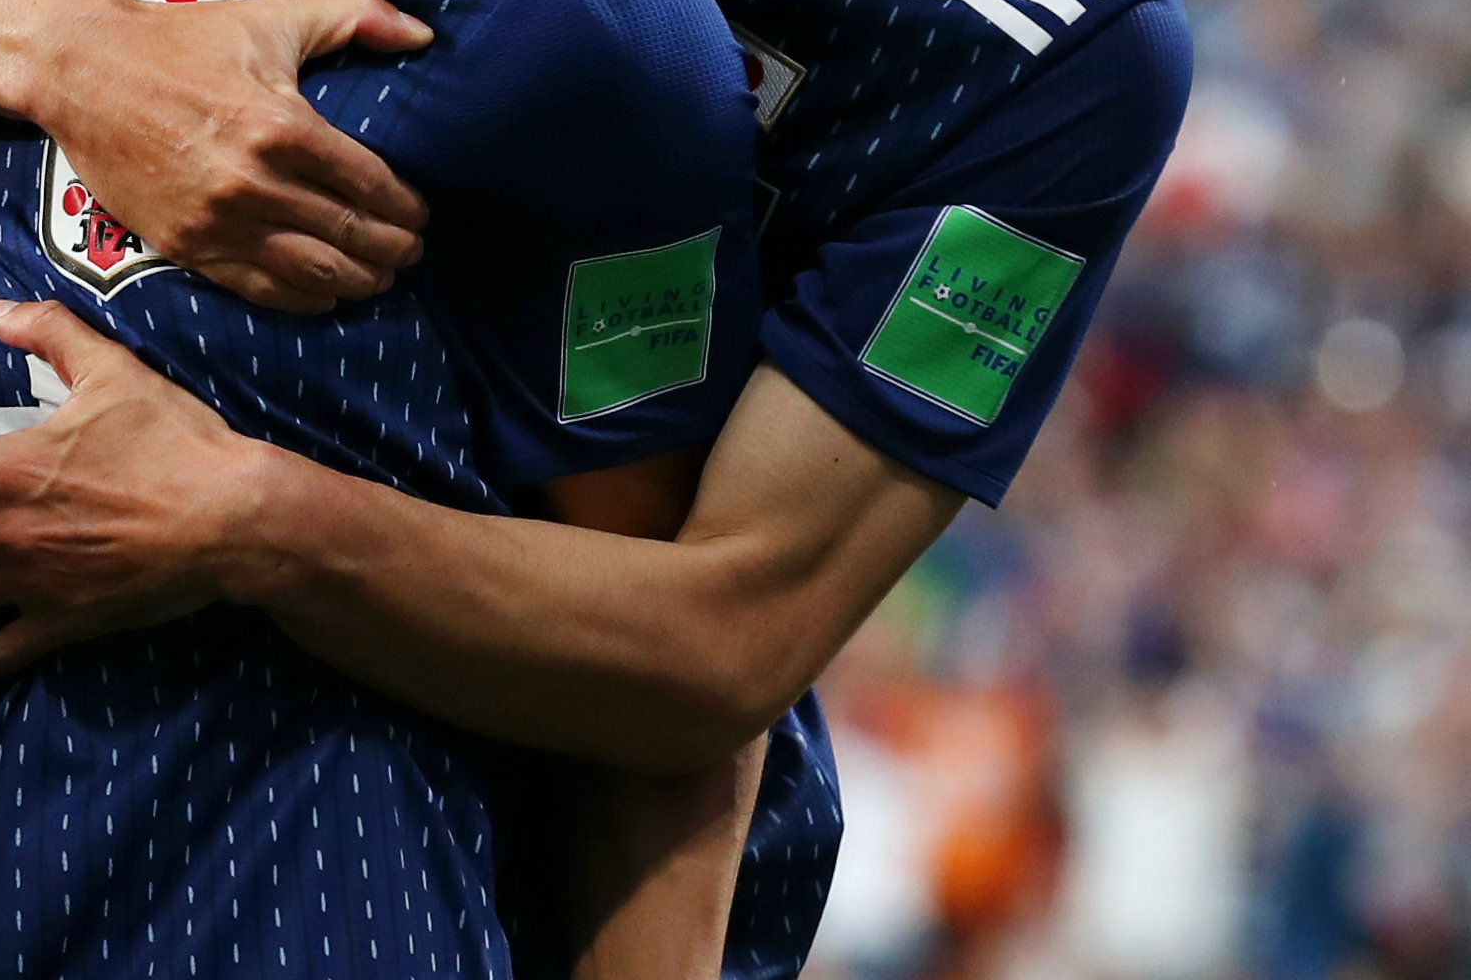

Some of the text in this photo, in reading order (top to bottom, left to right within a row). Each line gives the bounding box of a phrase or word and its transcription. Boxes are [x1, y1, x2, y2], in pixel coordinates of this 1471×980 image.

[72, 219, 143, 254] JFA
[929, 256, 1051, 324] LIVING
[650, 329, 699, 350] FIFA
[970, 344, 1020, 378] FIFA
